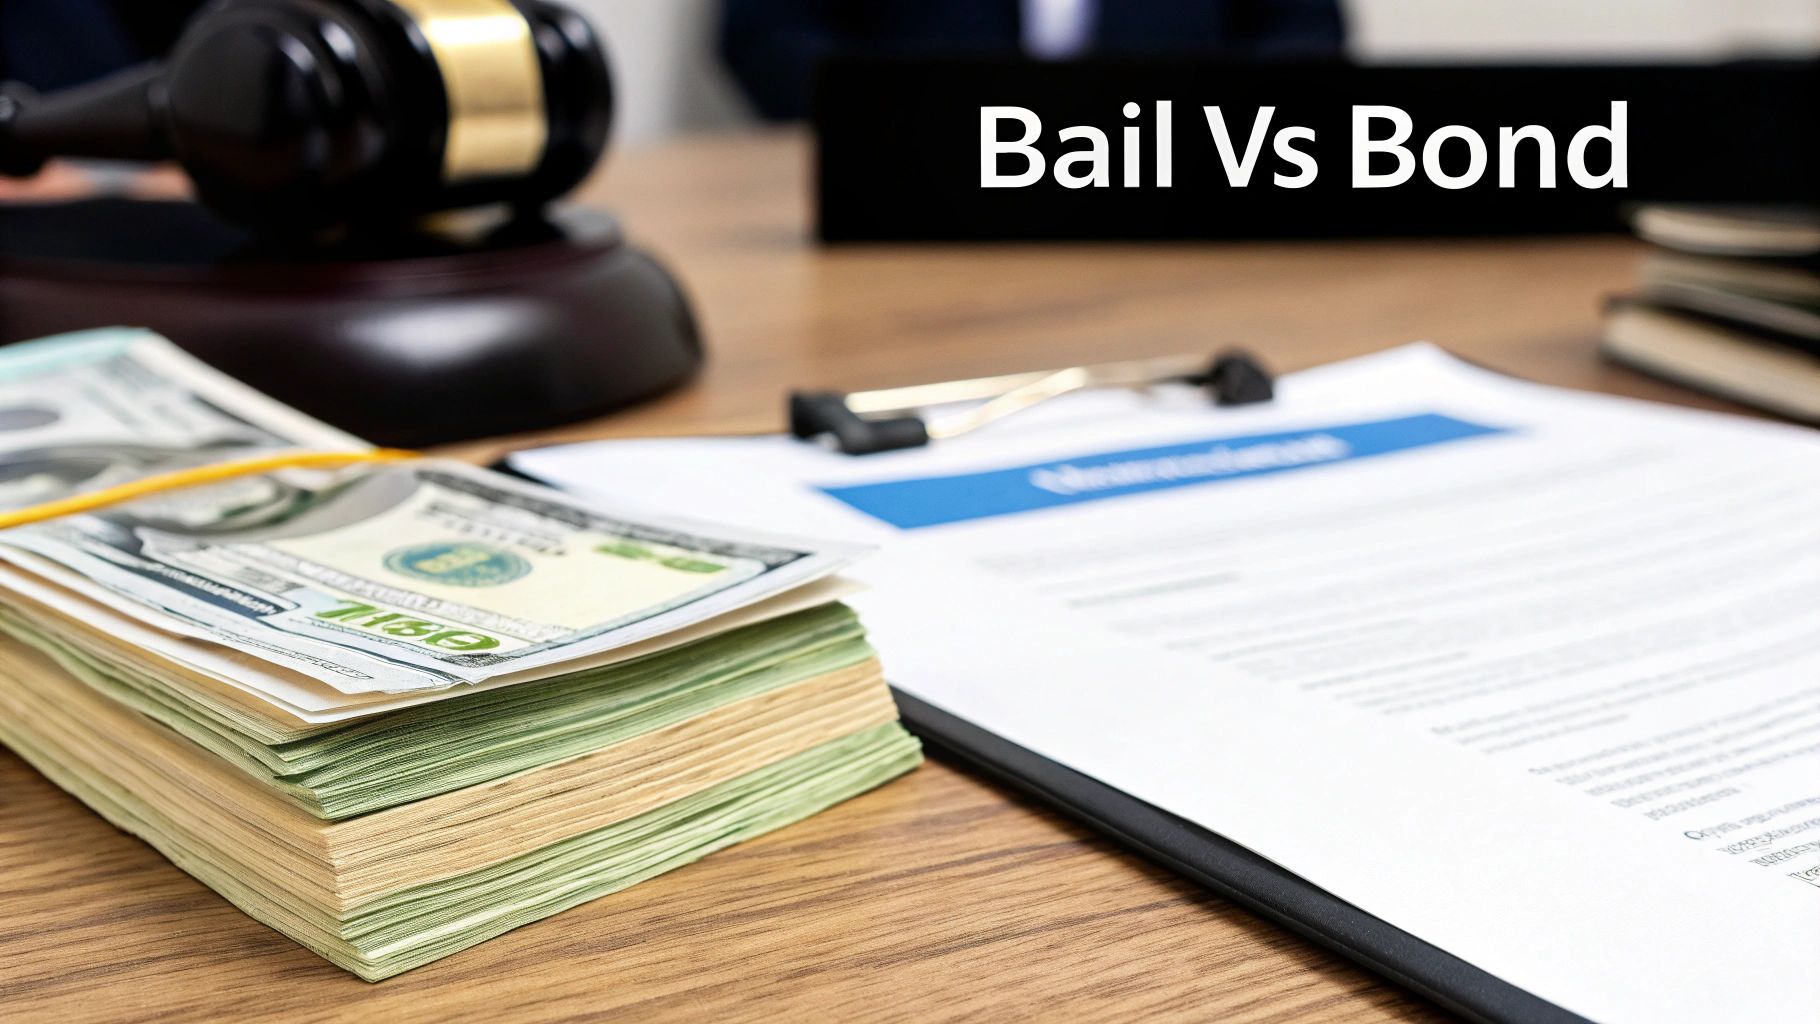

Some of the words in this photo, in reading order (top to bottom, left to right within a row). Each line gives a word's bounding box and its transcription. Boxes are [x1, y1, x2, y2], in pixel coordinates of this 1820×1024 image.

[980, 101, 1172, 188] Bail
[1204, 106, 1318, 188] Vs
[1352, 101, 1628, 189] Bond
